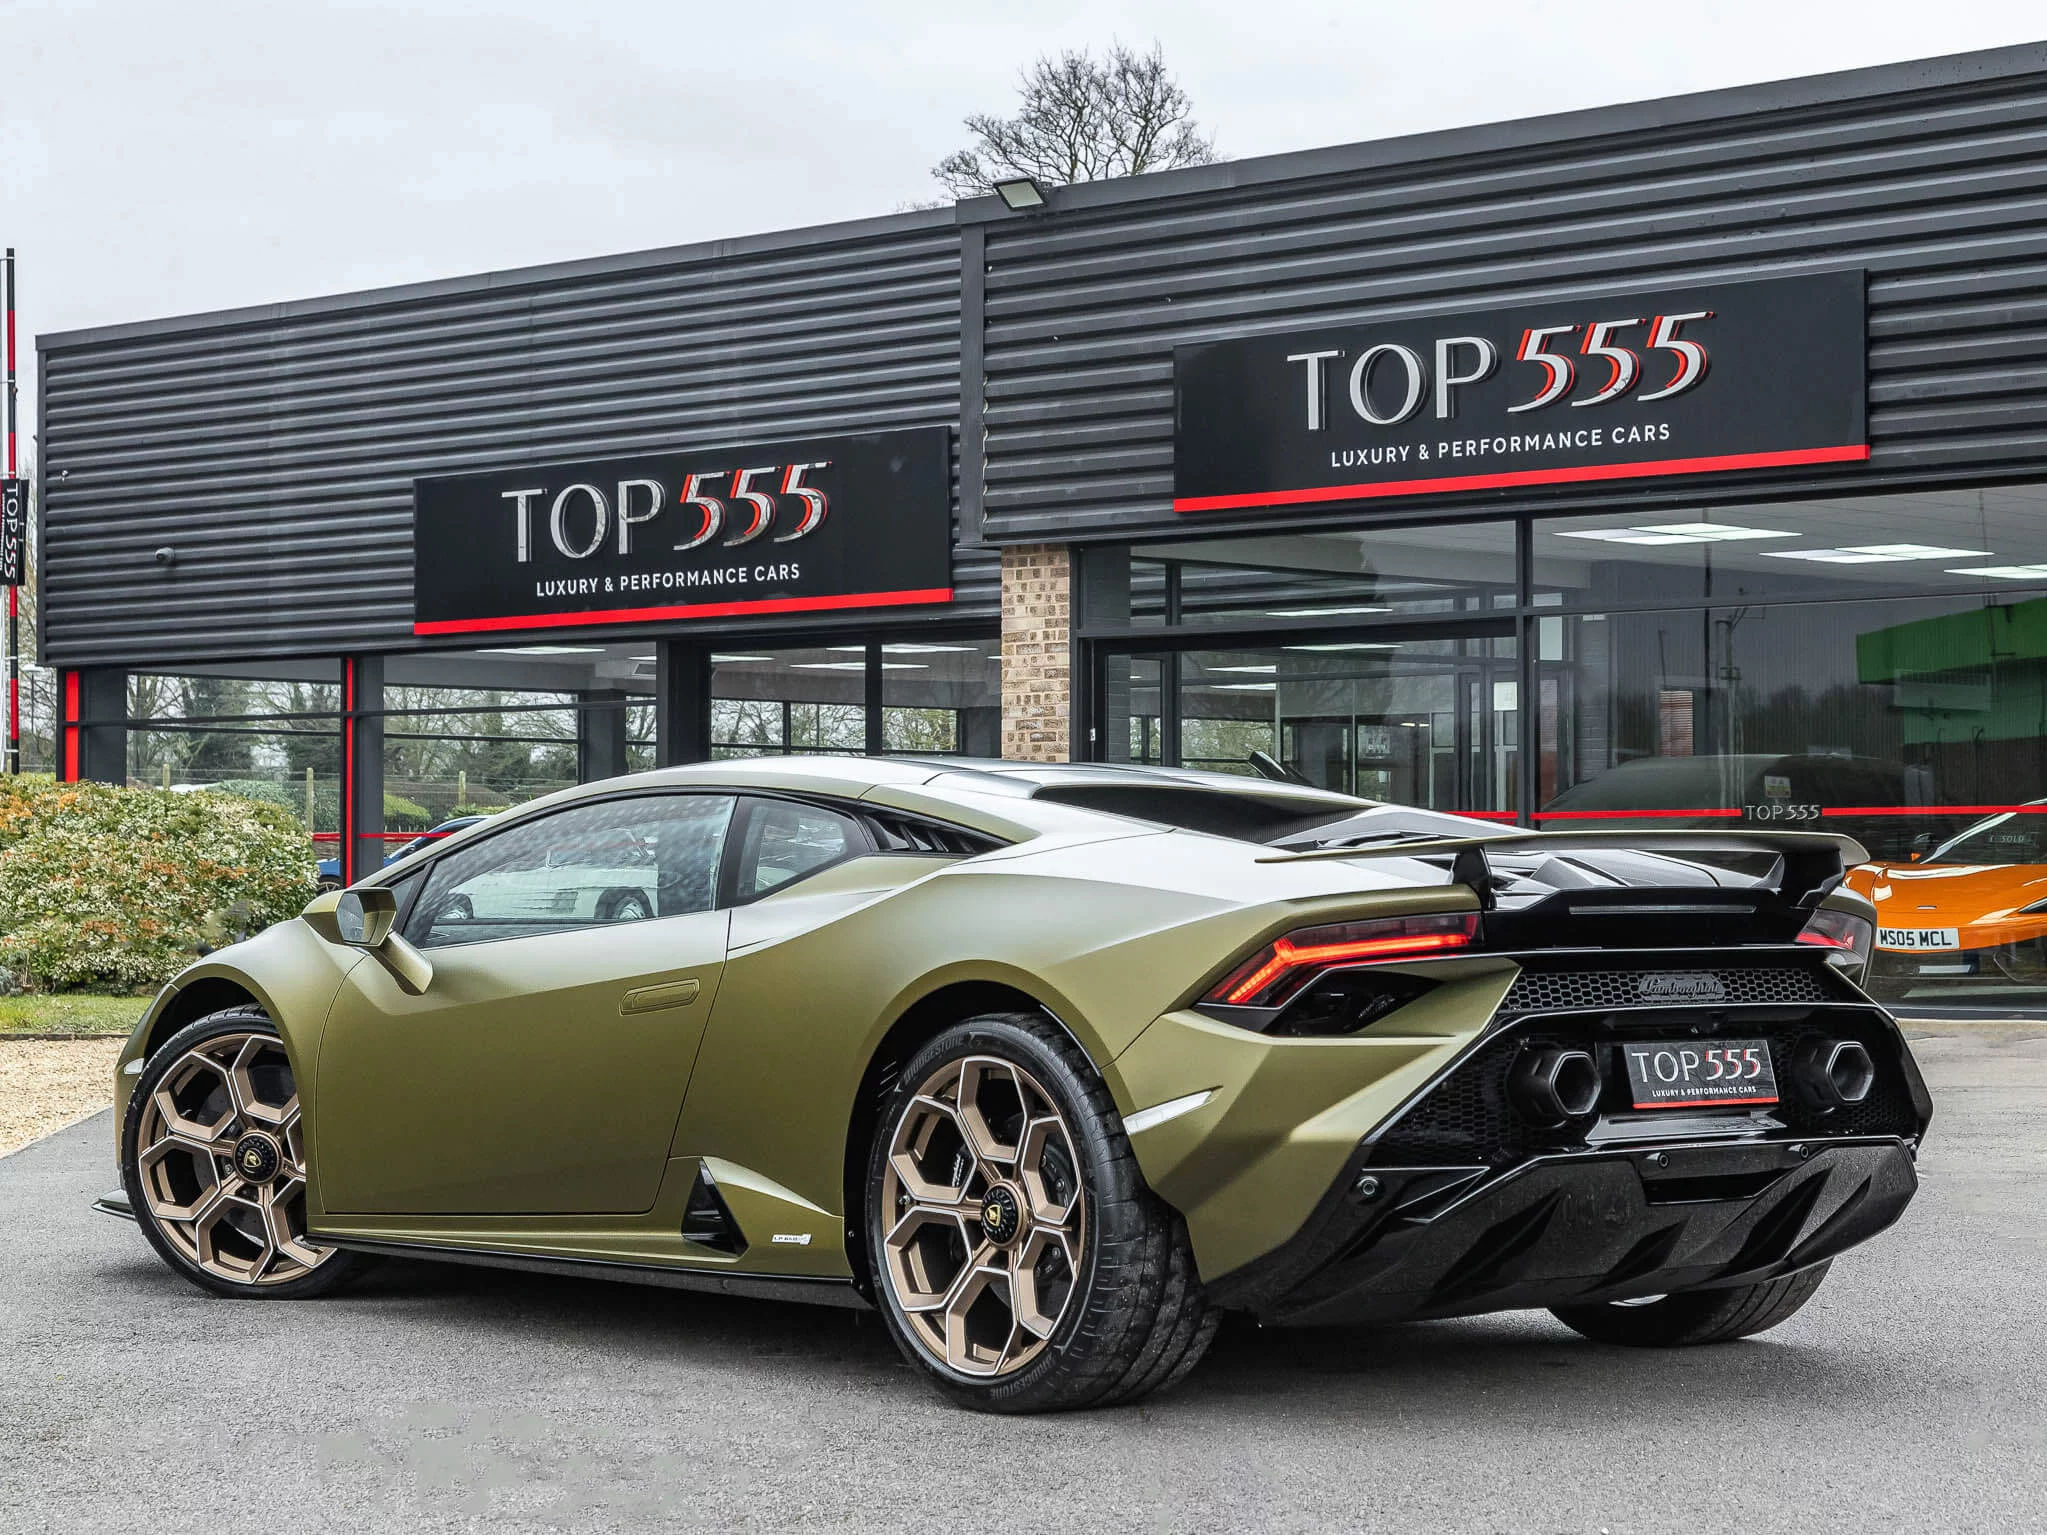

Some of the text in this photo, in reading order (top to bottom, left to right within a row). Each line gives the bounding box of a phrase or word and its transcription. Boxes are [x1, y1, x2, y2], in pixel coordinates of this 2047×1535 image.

[1286, 311, 1714, 431] TOP 555
[1331, 423, 1671, 468] LUXURY & PERFORMANCE CARS
[501, 460, 833, 563] TOP 555
[4, 482, 19, 580] TOP 555
[536, 563, 800, 598] LUXURY & PERFORMANCE CARS
[1744, 804, 1821, 820] TOP 555
[1919, 931, 1953, 947] MCL
[1631, 1048, 1762, 1083] TOP 555
[1651, 1088, 1679, 1098] LUXURY
[1686, 1086, 1738, 1097] PERFORMANCE
[1738, 1085, 1757, 1094] CARS
